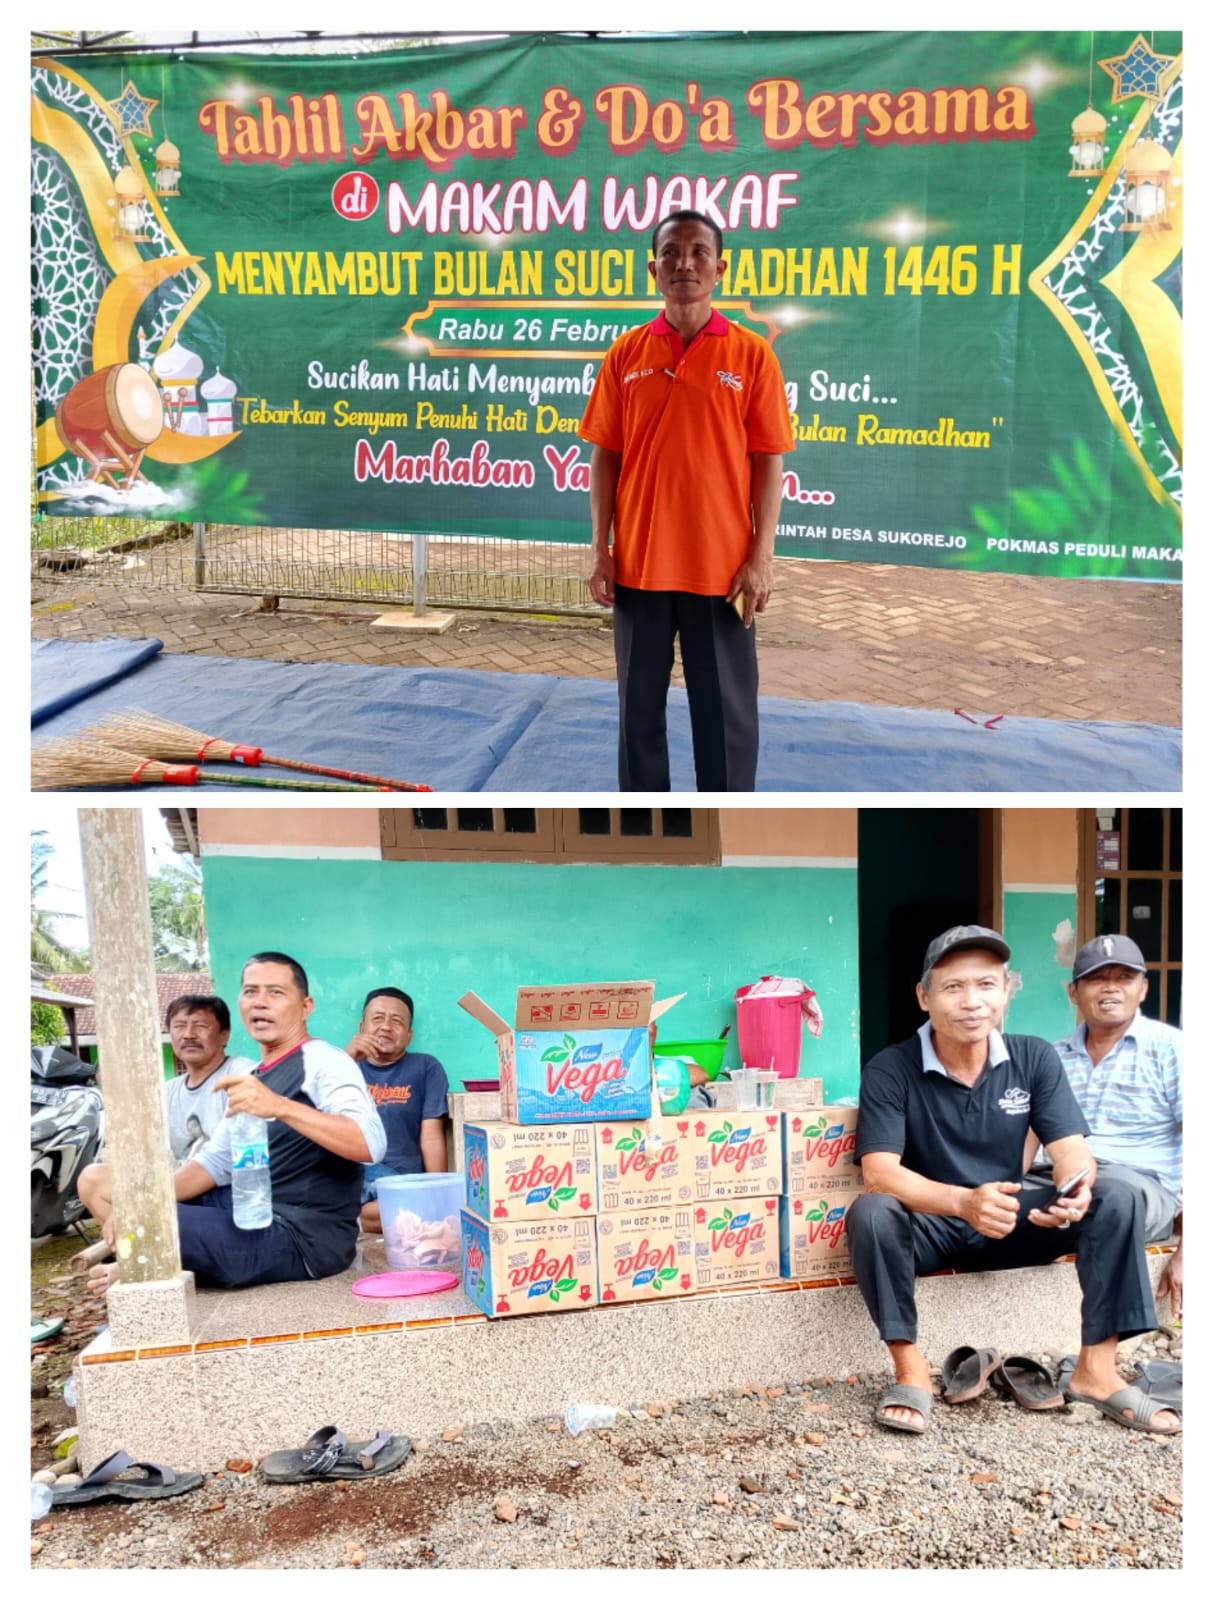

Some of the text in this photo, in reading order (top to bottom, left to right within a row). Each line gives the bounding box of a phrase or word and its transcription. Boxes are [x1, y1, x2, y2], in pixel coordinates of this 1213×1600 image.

[198, 78, 1031, 164] Tahlil Akbar & Do'a Bersama
[340, 171, 800, 234] di MAKAM WAKAF
[214, 251, 423, 297] MENYAMBUT
[433, 249, 543, 296] BULAN
[554, 249, 634, 296] SUCI
[883, 244, 977, 296] 1446
[991, 243, 1022, 296] H
[438, 318, 640, 342] Rabu 26 Febru
[307, 359, 399, 391] Sucikan
[407, 362, 459, 392] Hati
[468, 363, 597, 405] Menyamb
[808, 369, 898, 404] Suci...
[235, 396, 326, 425] Tebarkan
[334, 400, 408, 435] Senyum
[416, 401, 477, 430] Penuhi
[486, 404, 527, 433] Hati
[535, 404, 592, 442] Den
[354, 438, 535, 489] Marhaban
[832, 527, 873, 544] DESA
[877, 530, 967, 550] SUKOREJO
[986, 537, 1060, 556] POKMAS
[1064, 541, 1127, 560] PEDULI
[577, 1048, 599, 1062] New
[546, 1058, 628, 1104] Vega
[513, 1132, 524, 1142] ml
[528, 1131, 546, 1142] 220
[555, 1131, 569, 1140] 40
[619, 1145, 679, 1182] Vega
[710, 1137, 768, 1173] Vega
[505, 1154, 573, 1193] Vega
[624, 1197, 635, 1206] 40
[644, 1195, 659, 1205] 220
[660, 1193, 672, 1203] ml
[715, 1187, 725, 1196] 40
[734, 1185, 748, 1194] 220
[750, 1184, 760, 1193] ml
[515, 1227, 527, 1237] ml
[530, 1225, 546, 1236] 220
[557, 1224, 569, 1234] 40
[620, 1218, 630, 1228] ml
[634, 1216, 649, 1226] 220
[660, 1215, 670, 1224] 40
[809, 1218, 847, 1249] Veg
[709, 1222, 766, 1258] Vega
[508, 1248, 574, 1287] Vega
[614, 1238, 675, 1277] Vega
[715, 1272, 725, 1280] 40
[733, 1270, 748, 1279] 220
[750, 1268, 760, 1277] ml
